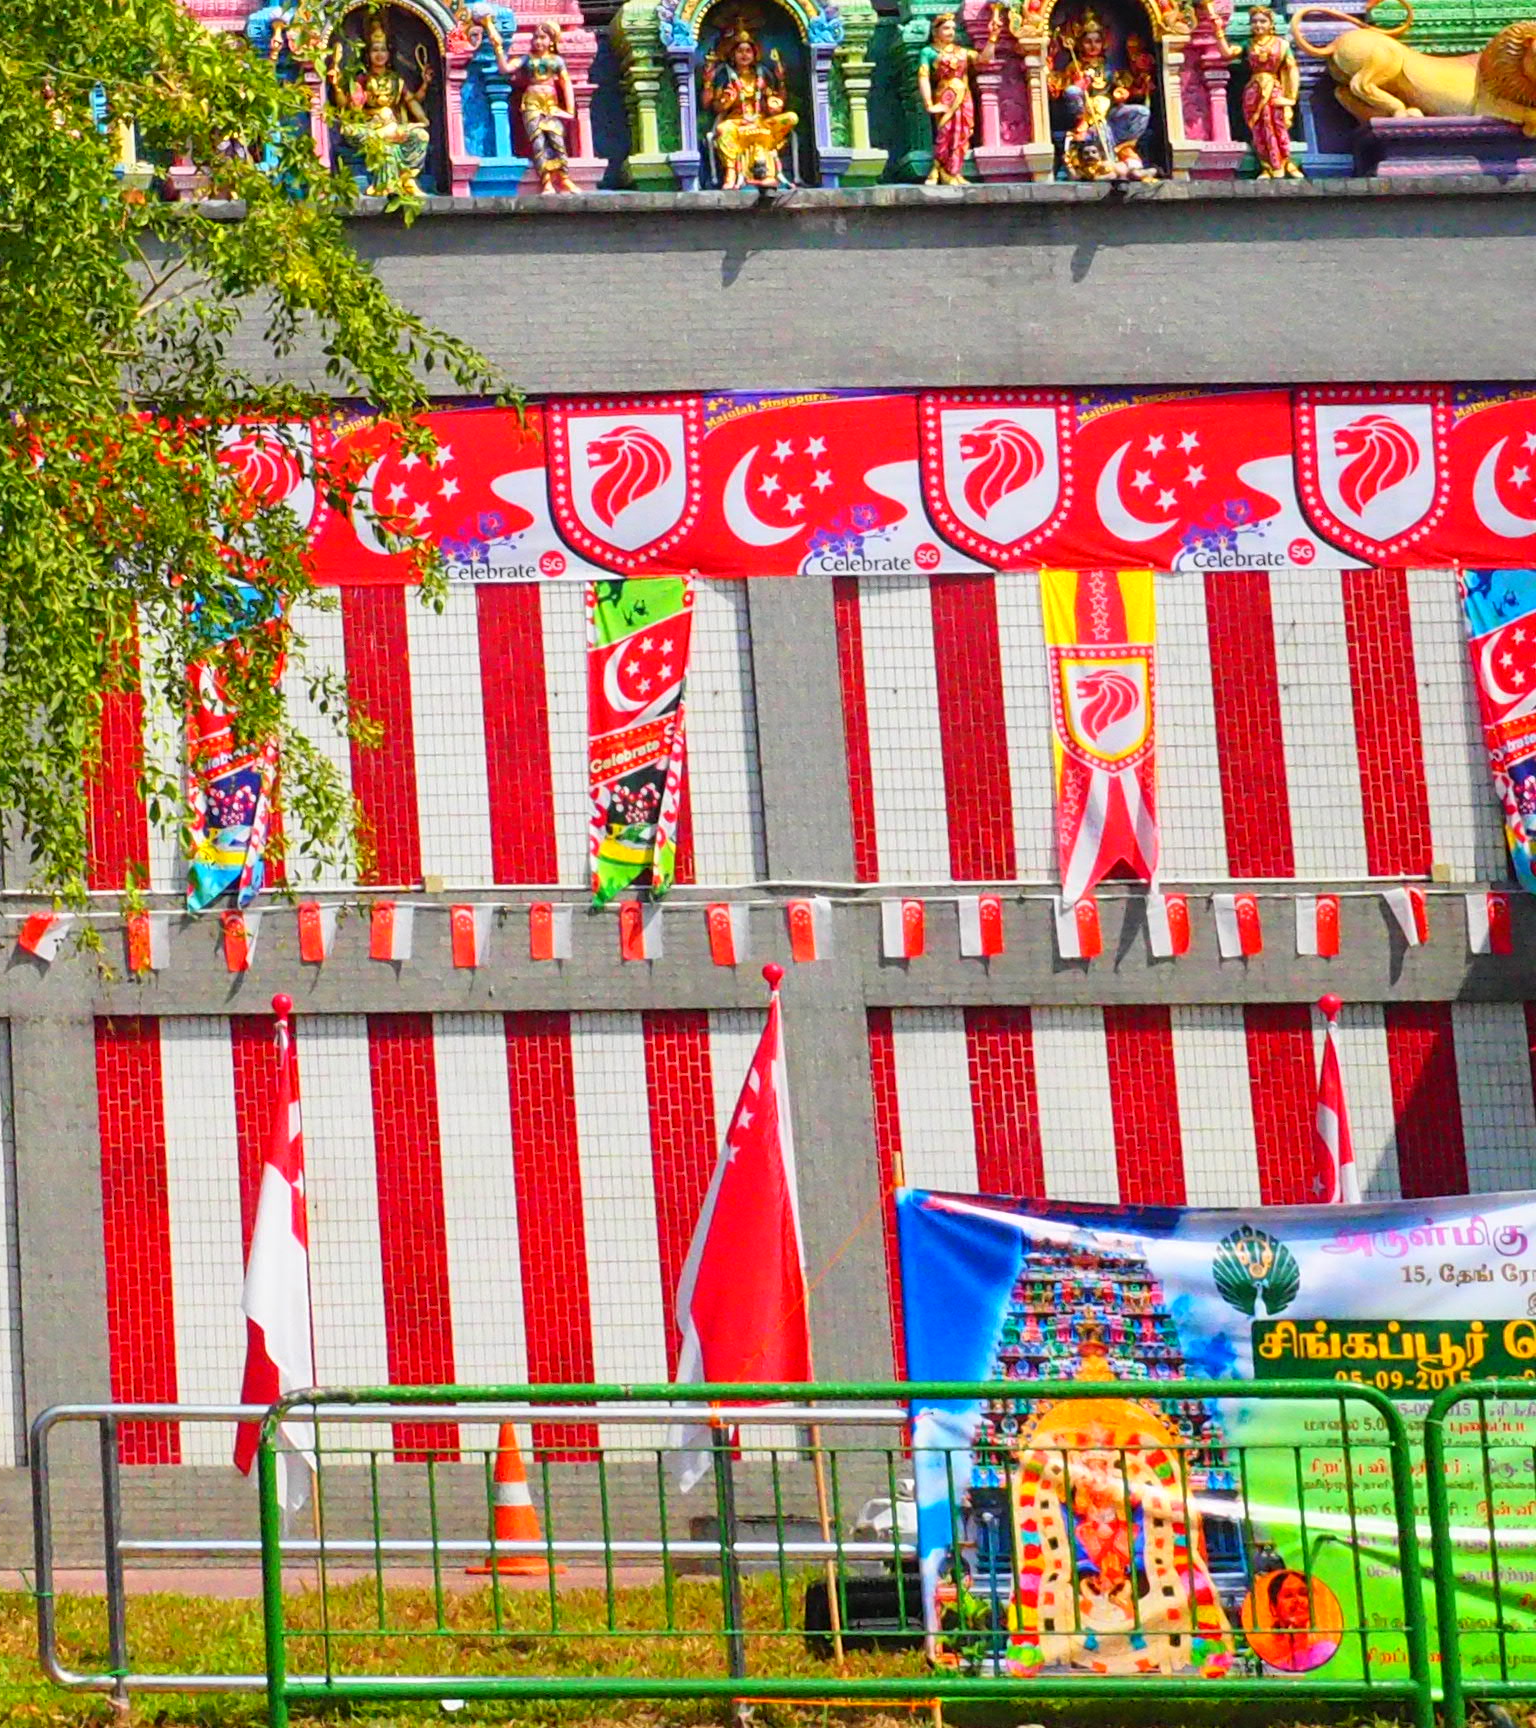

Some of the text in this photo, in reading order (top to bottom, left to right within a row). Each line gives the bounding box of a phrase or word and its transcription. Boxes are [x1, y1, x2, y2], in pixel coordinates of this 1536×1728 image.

[917, 550, 939, 562] SG
[1193, 550, 1285, 568] Celebrate
[1291, 544, 1313, 558] SG
[445, 559, 537, 581] Celebrate
[542, 557, 564, 571] SG
[820, 554, 912, 572] Celebrate
[590, 740, 661, 774] Celebrate
[1401, 1265, 1433, 1287] 15,
[1258, 1320, 1489, 1373] சிங்கப்பூர்
